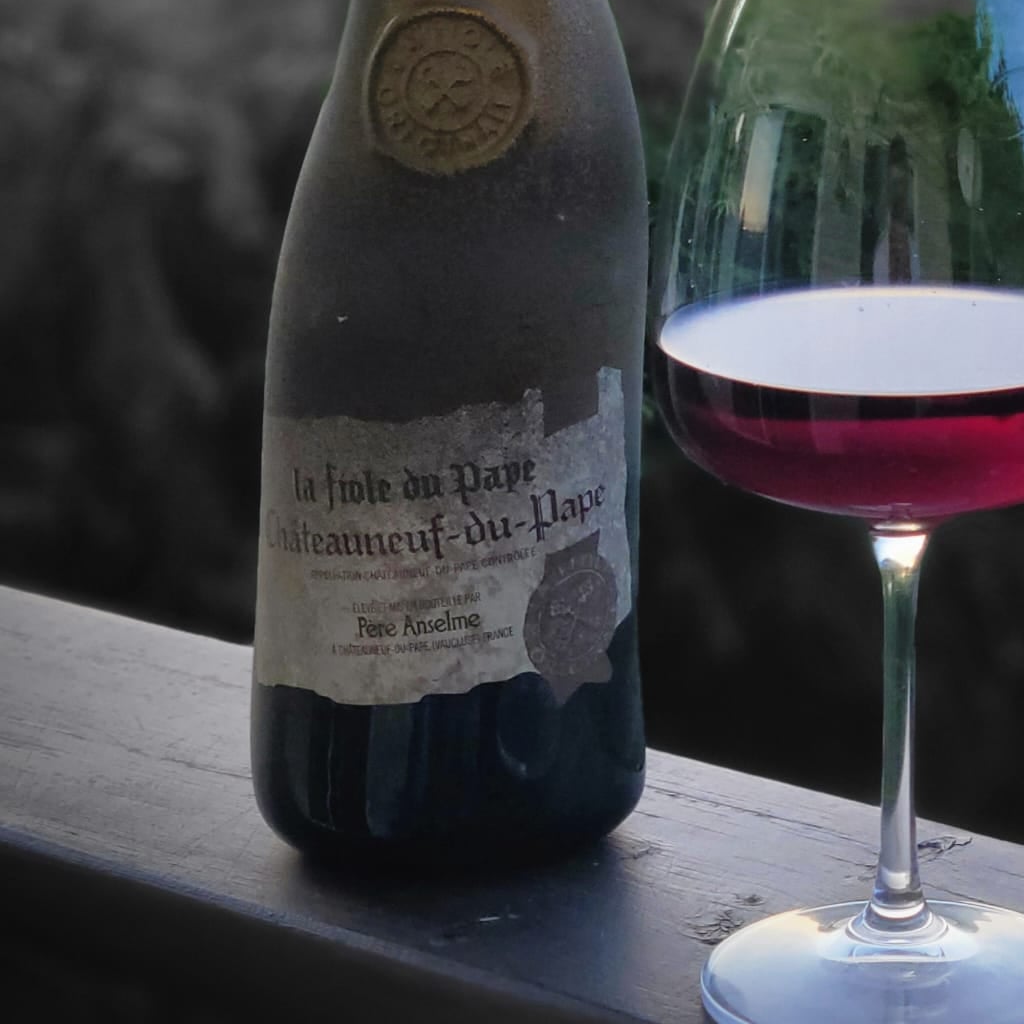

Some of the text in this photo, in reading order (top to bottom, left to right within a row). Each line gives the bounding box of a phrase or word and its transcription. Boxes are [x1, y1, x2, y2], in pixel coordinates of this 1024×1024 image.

[294, 459, 536, 513] la fiole du Pape
[357, 610, 480, 638] Père Anselme
